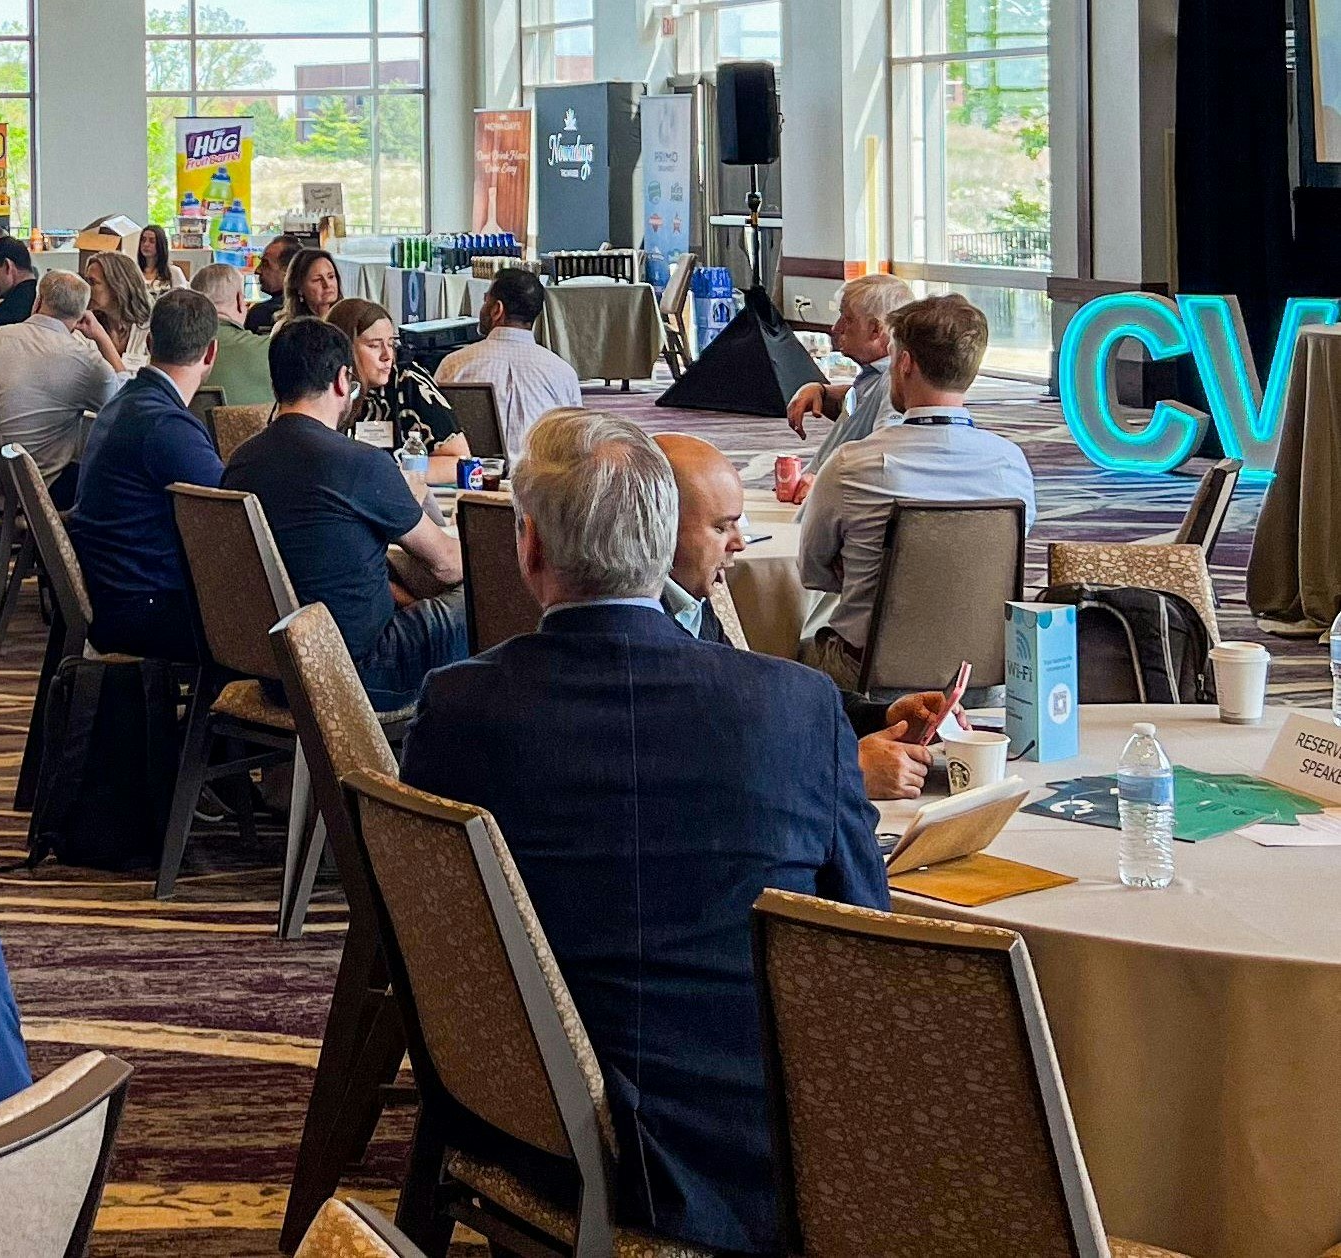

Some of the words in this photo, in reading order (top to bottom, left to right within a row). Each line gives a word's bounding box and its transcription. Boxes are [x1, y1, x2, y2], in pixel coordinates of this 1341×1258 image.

[548, 132, 594, 181] Nowadays
[1007, 660, 1033, 682] Wi-Fi
[1295, 732, 1341, 760] RESERV
